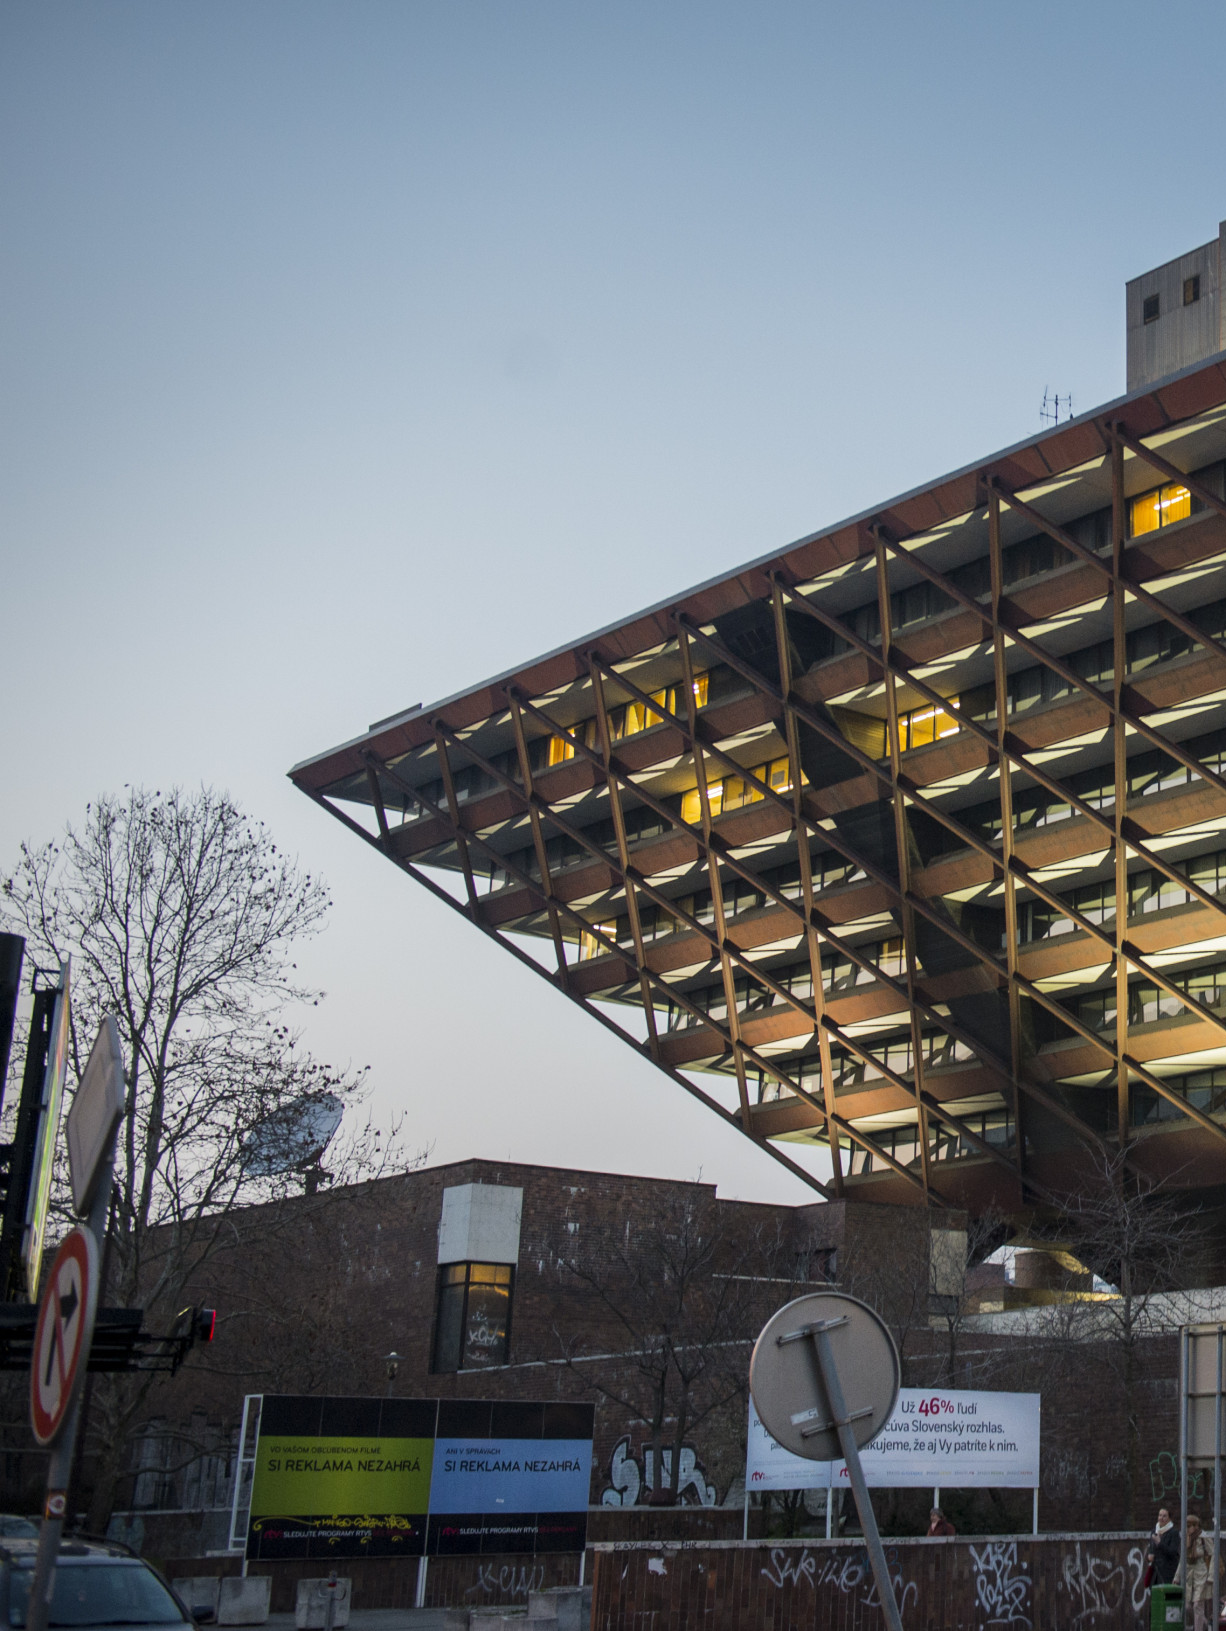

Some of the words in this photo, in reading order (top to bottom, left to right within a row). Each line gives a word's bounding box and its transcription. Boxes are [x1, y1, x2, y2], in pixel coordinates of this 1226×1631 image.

[901, 1400, 915, 1414] Už
[918, 1397, 954, 1416] 46%
[957, 1402, 978, 1414] ľudí
[912, 1420, 964, 1436] Slovenský
[967, 1421, 1005, 1434] rozhlas.
[283, 1445, 309, 1453] VAŠOM
[913, 1438, 925, 1451] že
[927, 1440, 937, 1454] aj
[939, 1439, 951, 1453] Vy
[989, 1439, 994, 1450] k
[268, 1459, 281, 1471] SI
[285, 1459, 353, 1472] REKLAMA
[358, 1457, 420, 1472] NEZAHRÁ
[444, 1460, 456, 1472] SI
[460, 1460, 520, 1472] REKLAMA
[524, 1458, 581, 1472] NEZAHRÁ
[318, 1530, 355, 1538] PROGRAMY
[460, 1527, 488, 1535] SLEDUJTE
